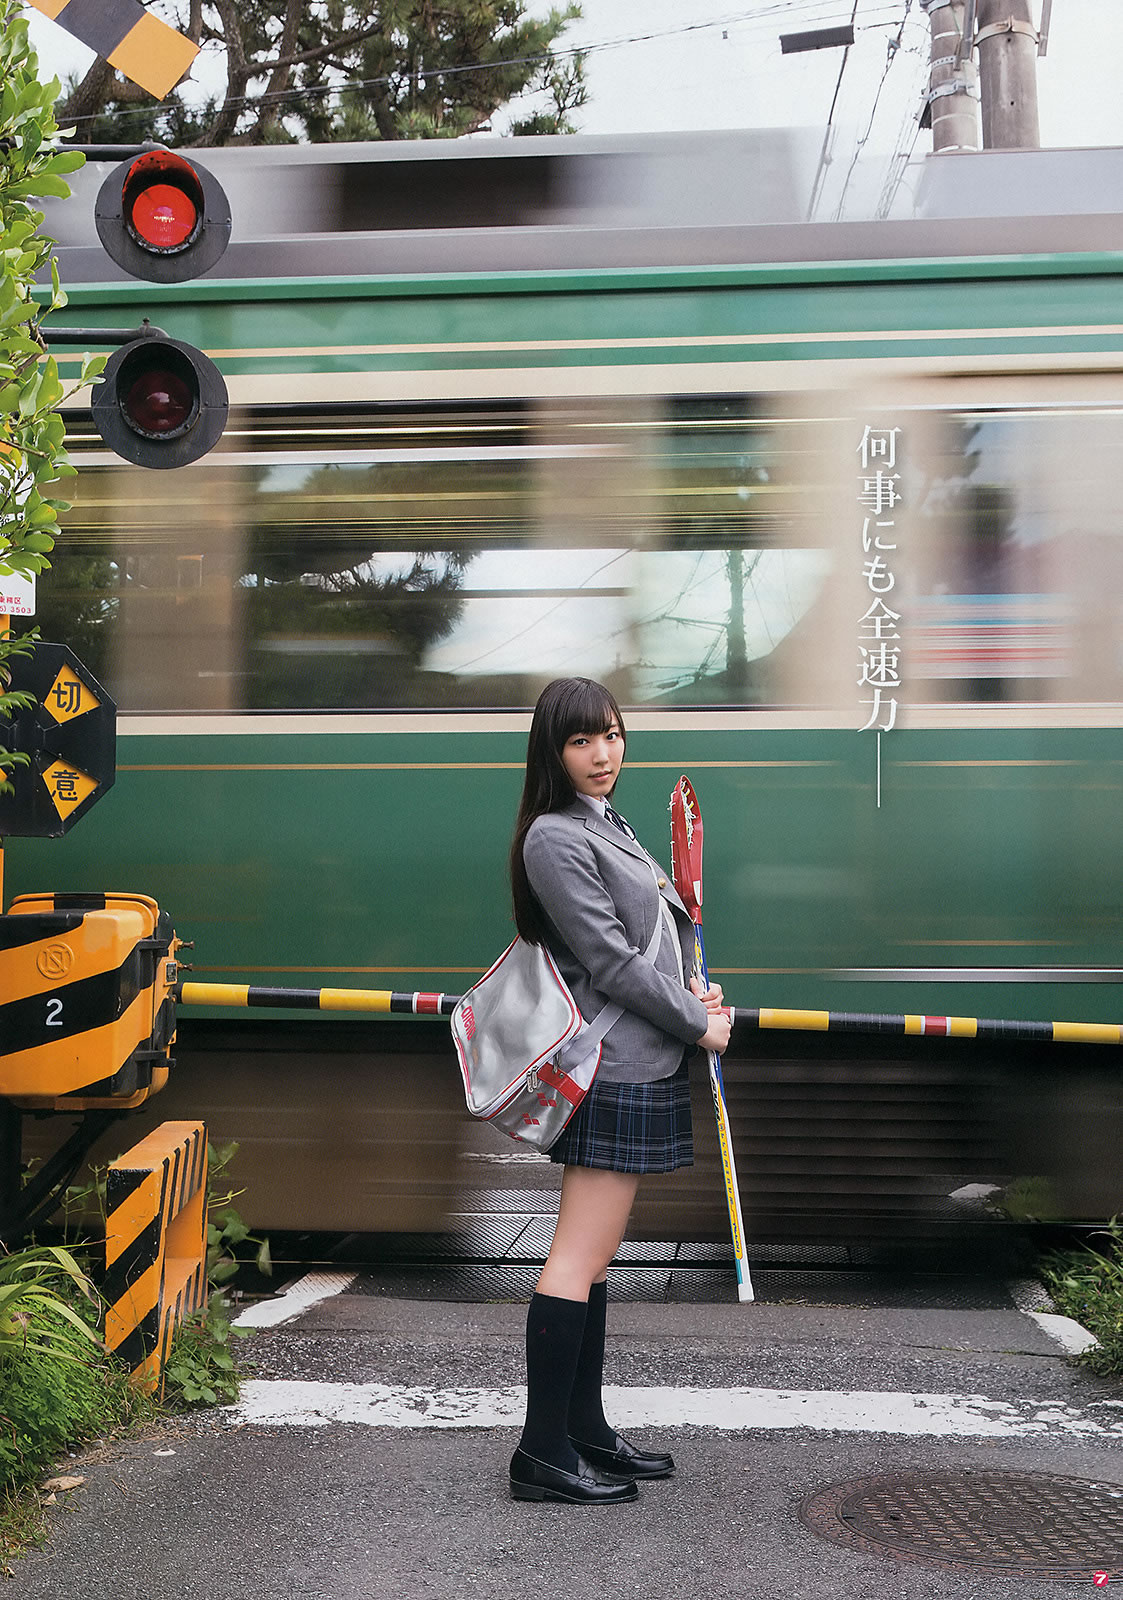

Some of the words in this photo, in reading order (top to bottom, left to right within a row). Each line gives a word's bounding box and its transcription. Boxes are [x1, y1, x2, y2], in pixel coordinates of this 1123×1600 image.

[10, 606, 32, 614] 3503
[52, 681, 81, 713] 切
[51, 769, 80, 801] 意
[46, 998, 63, 1026] 2
[461, 1005, 476, 1041] arena
